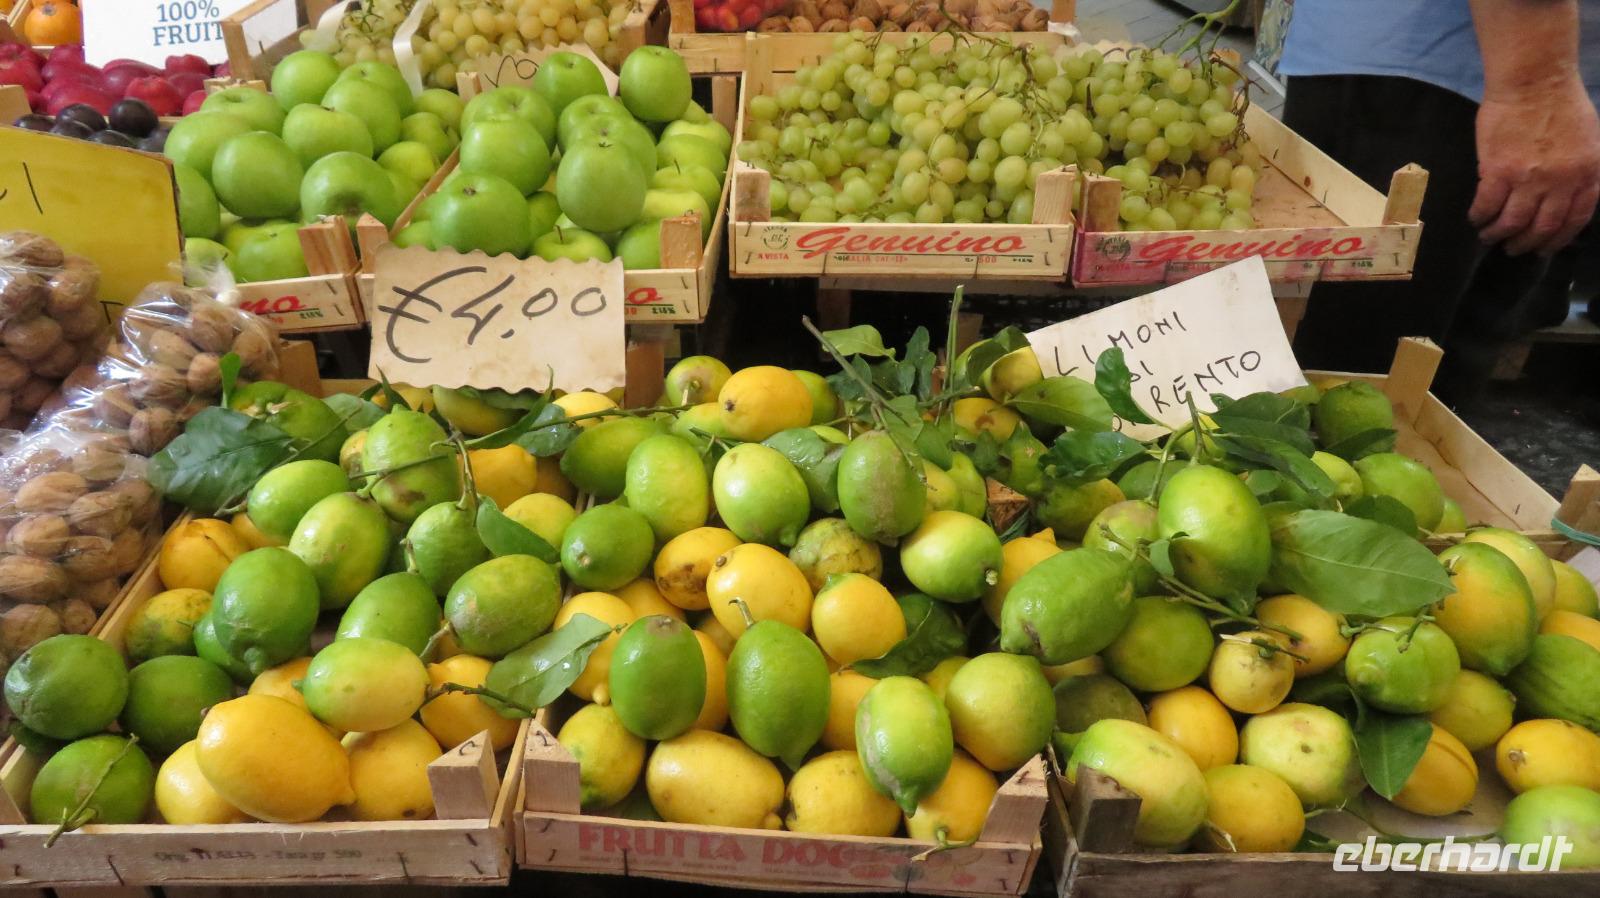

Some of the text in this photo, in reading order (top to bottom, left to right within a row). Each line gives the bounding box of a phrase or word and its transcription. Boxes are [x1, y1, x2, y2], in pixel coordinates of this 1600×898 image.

[157, 0, 220, 22] 100%
[152, 21, 223, 46] FRUIT
[796, 227, 1026, 260] Genuino
[1139, 234, 1366, 269] Genuino
[1055, 311, 1187, 376] LIMONI
